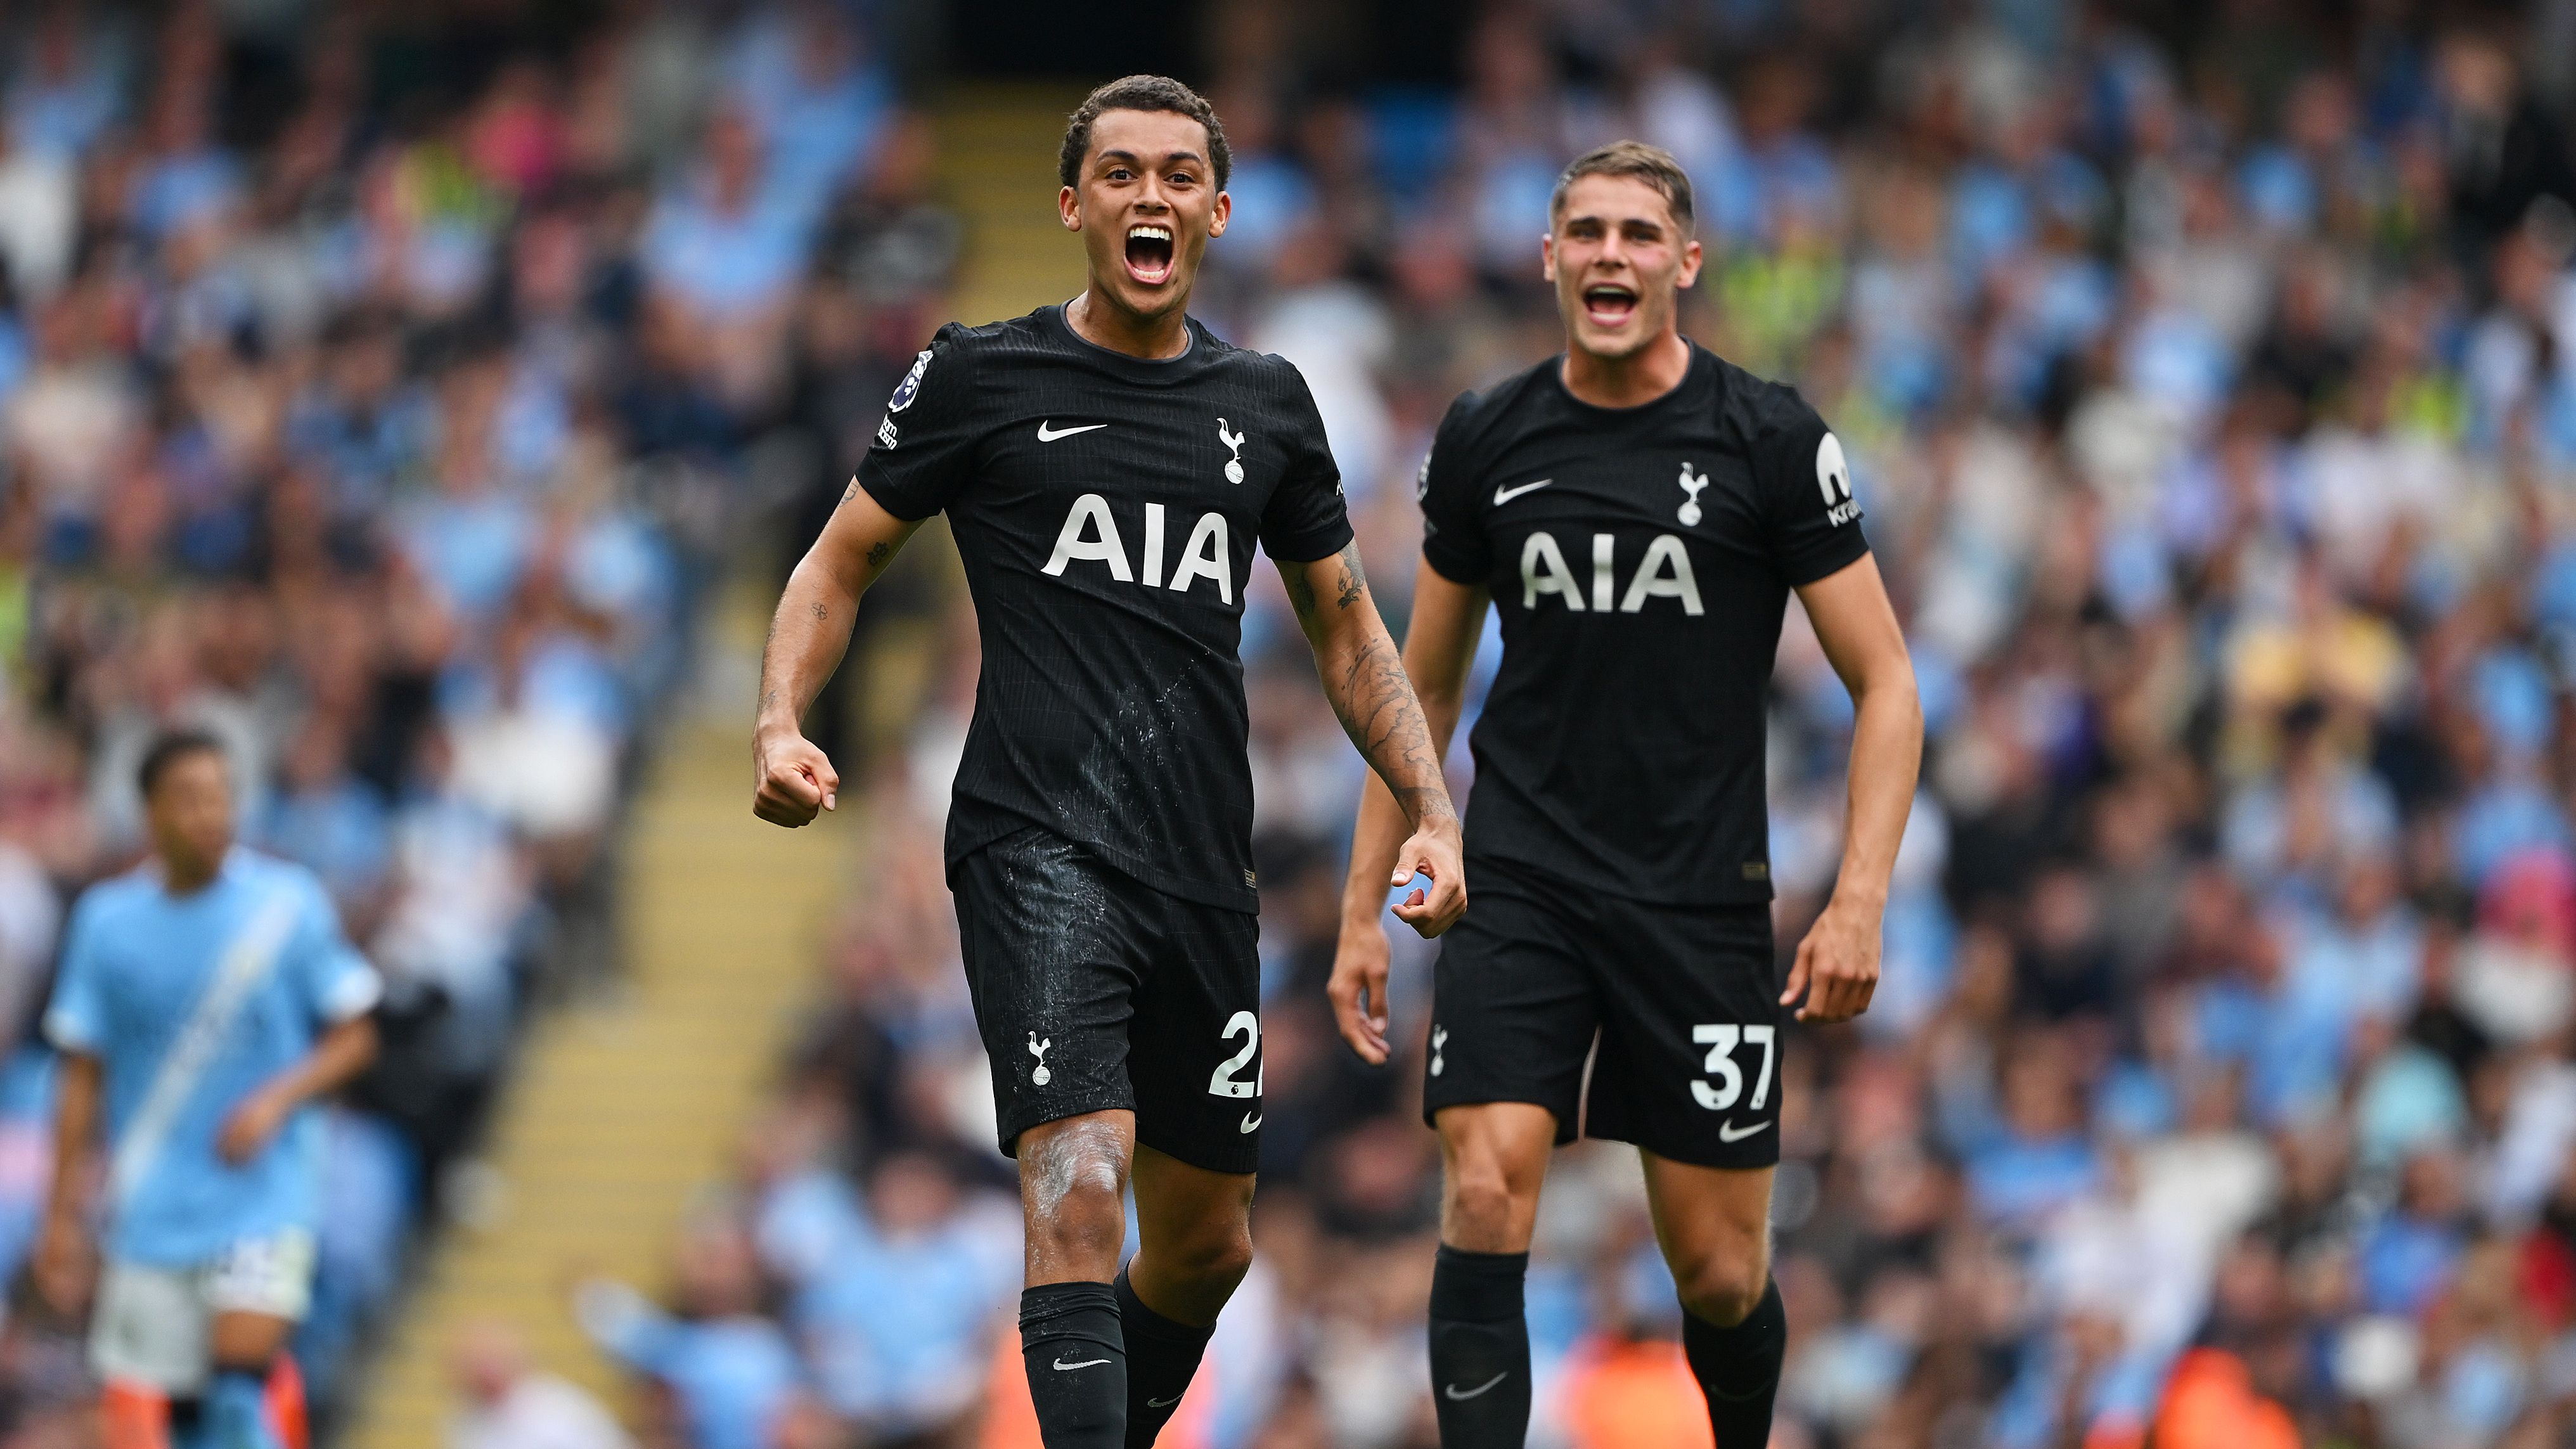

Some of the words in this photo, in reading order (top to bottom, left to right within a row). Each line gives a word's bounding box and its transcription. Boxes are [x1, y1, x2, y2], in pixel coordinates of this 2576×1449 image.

[1040, 494, 1232, 605] AIA
[1521, 532, 1705, 615] AIA
[1208, 1010, 1263, 1098] 2
[1690, 1024, 1775, 1110] 37
